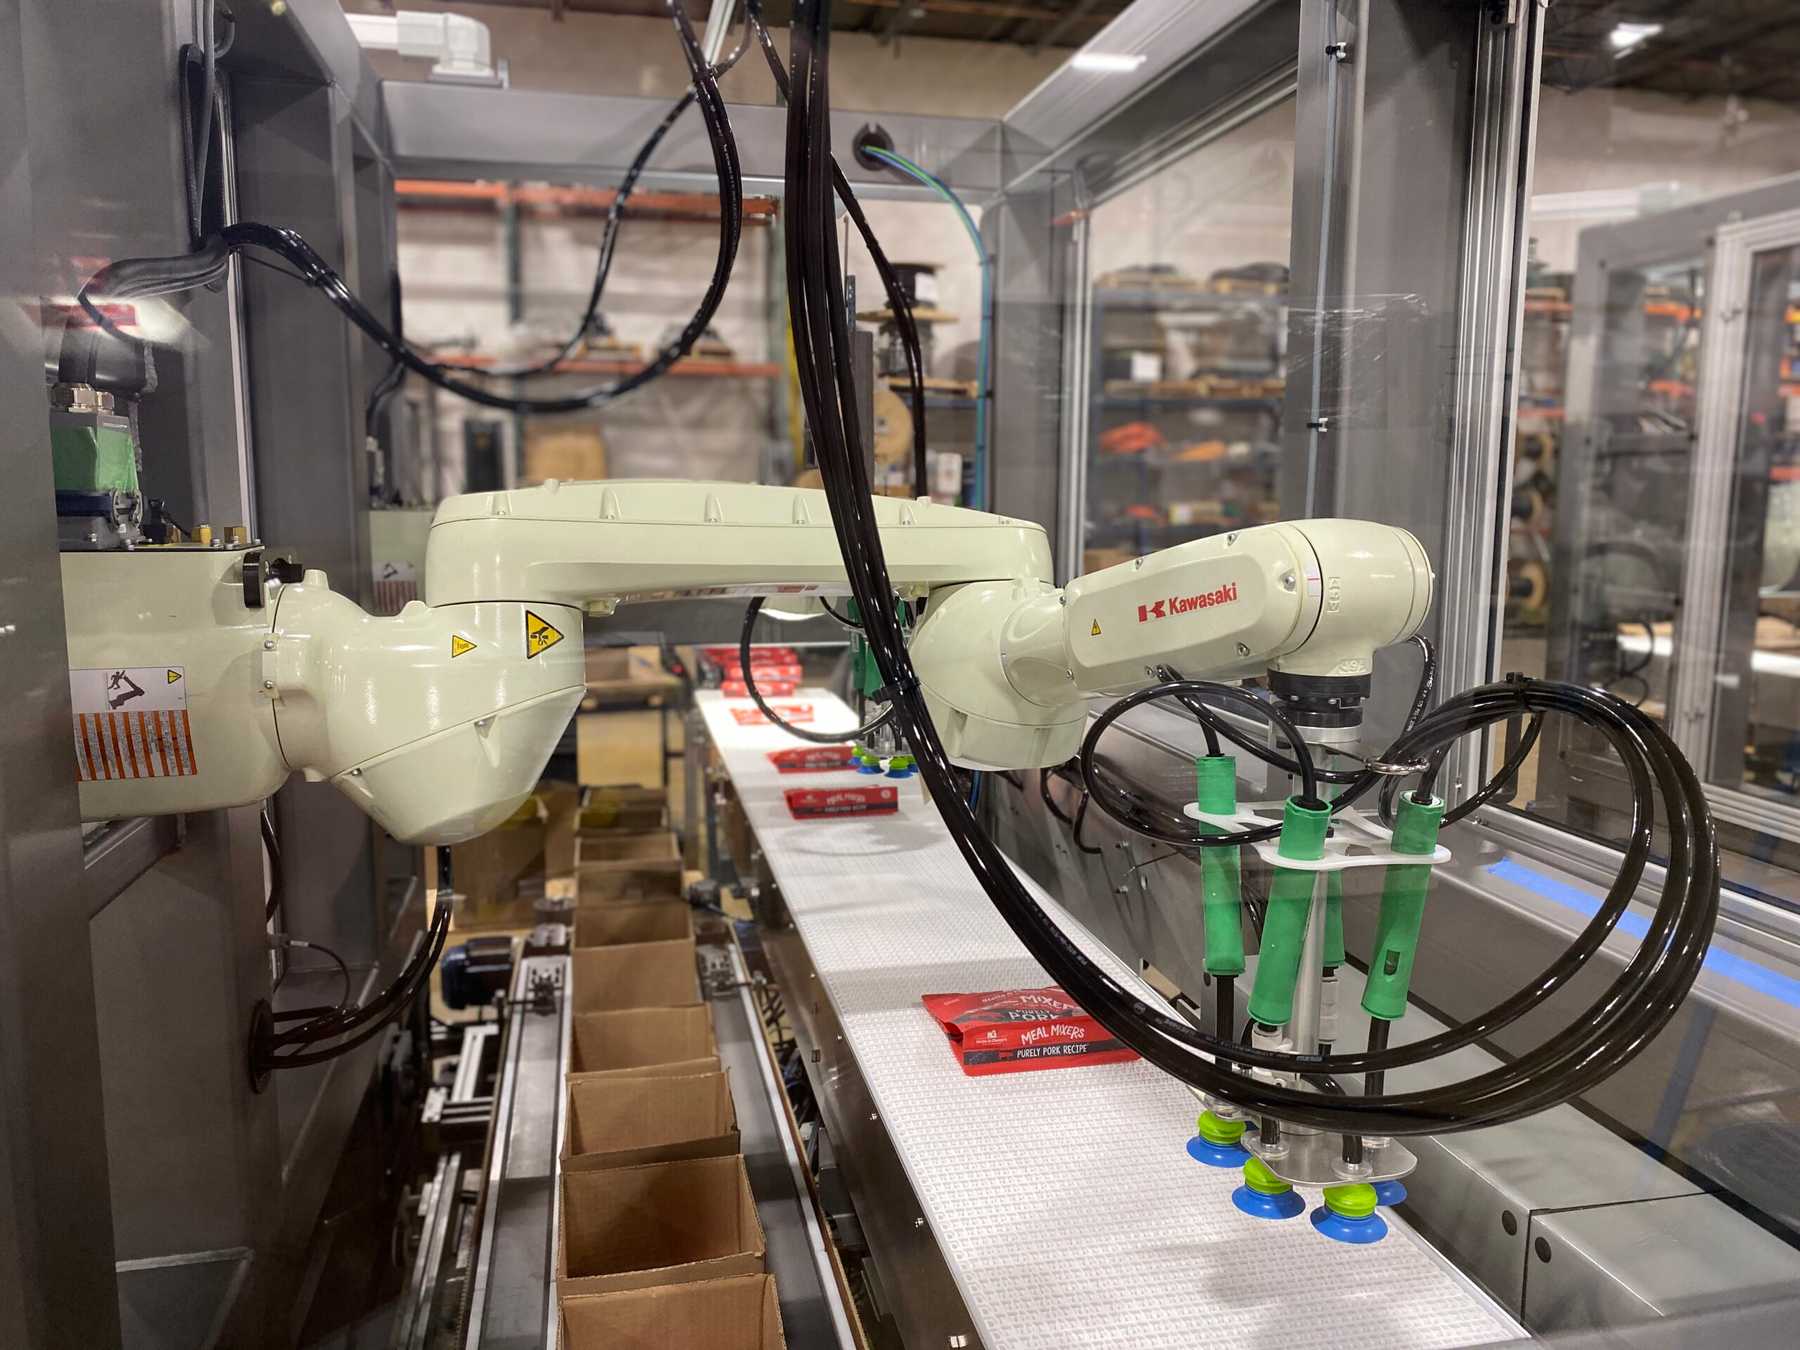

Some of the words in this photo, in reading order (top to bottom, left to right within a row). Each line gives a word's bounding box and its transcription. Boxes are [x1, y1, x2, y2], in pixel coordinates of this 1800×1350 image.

[1168, 582, 1238, 615] Kawasaki
[1020, 995, 1075, 1010] MIXER
[1020, 1027, 1049, 1045] MEAL
[1051, 1025, 1085, 1040] MIXERS
[1017, 1047, 1041, 1058] PURELY
[1042, 1046, 1061, 1057] PORK
[1063, 1044, 1087, 1055] RECIPE
